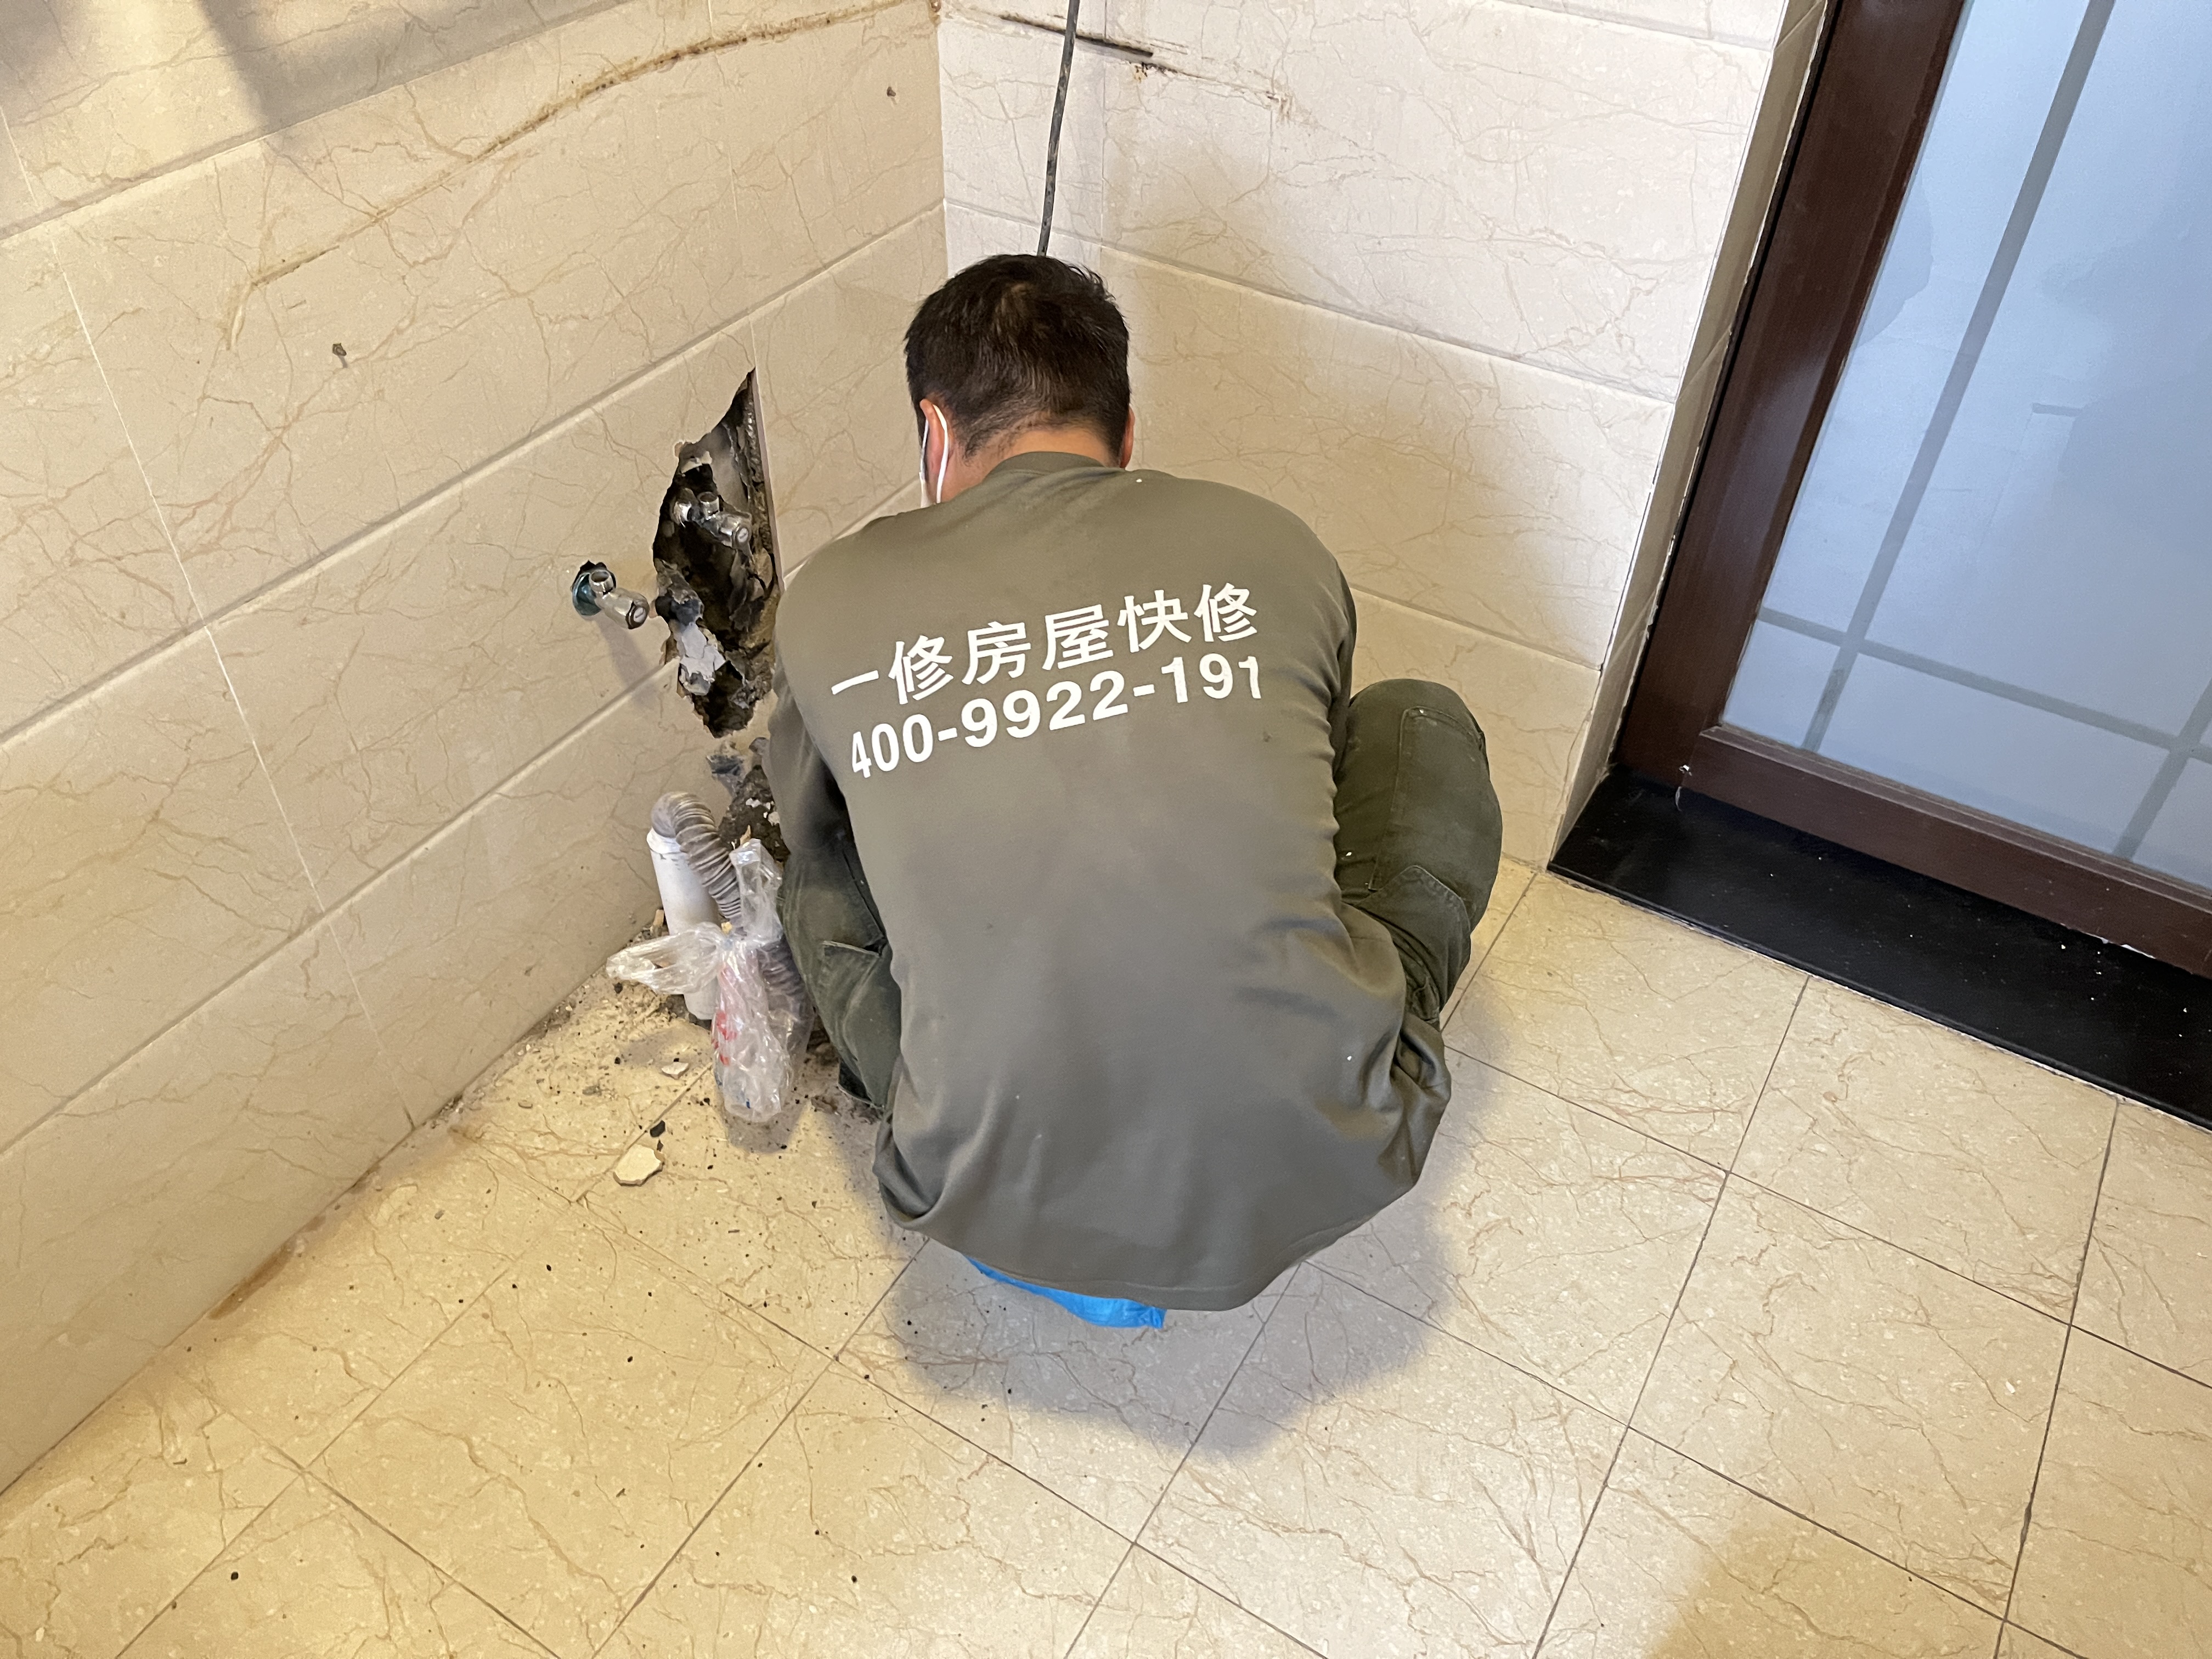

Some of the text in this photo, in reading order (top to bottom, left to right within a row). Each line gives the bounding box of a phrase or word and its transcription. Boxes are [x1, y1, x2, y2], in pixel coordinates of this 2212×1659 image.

[831, 582, 1258, 705] 一修房屋快修
[851, 653, 1262, 778] 400-9922-191
